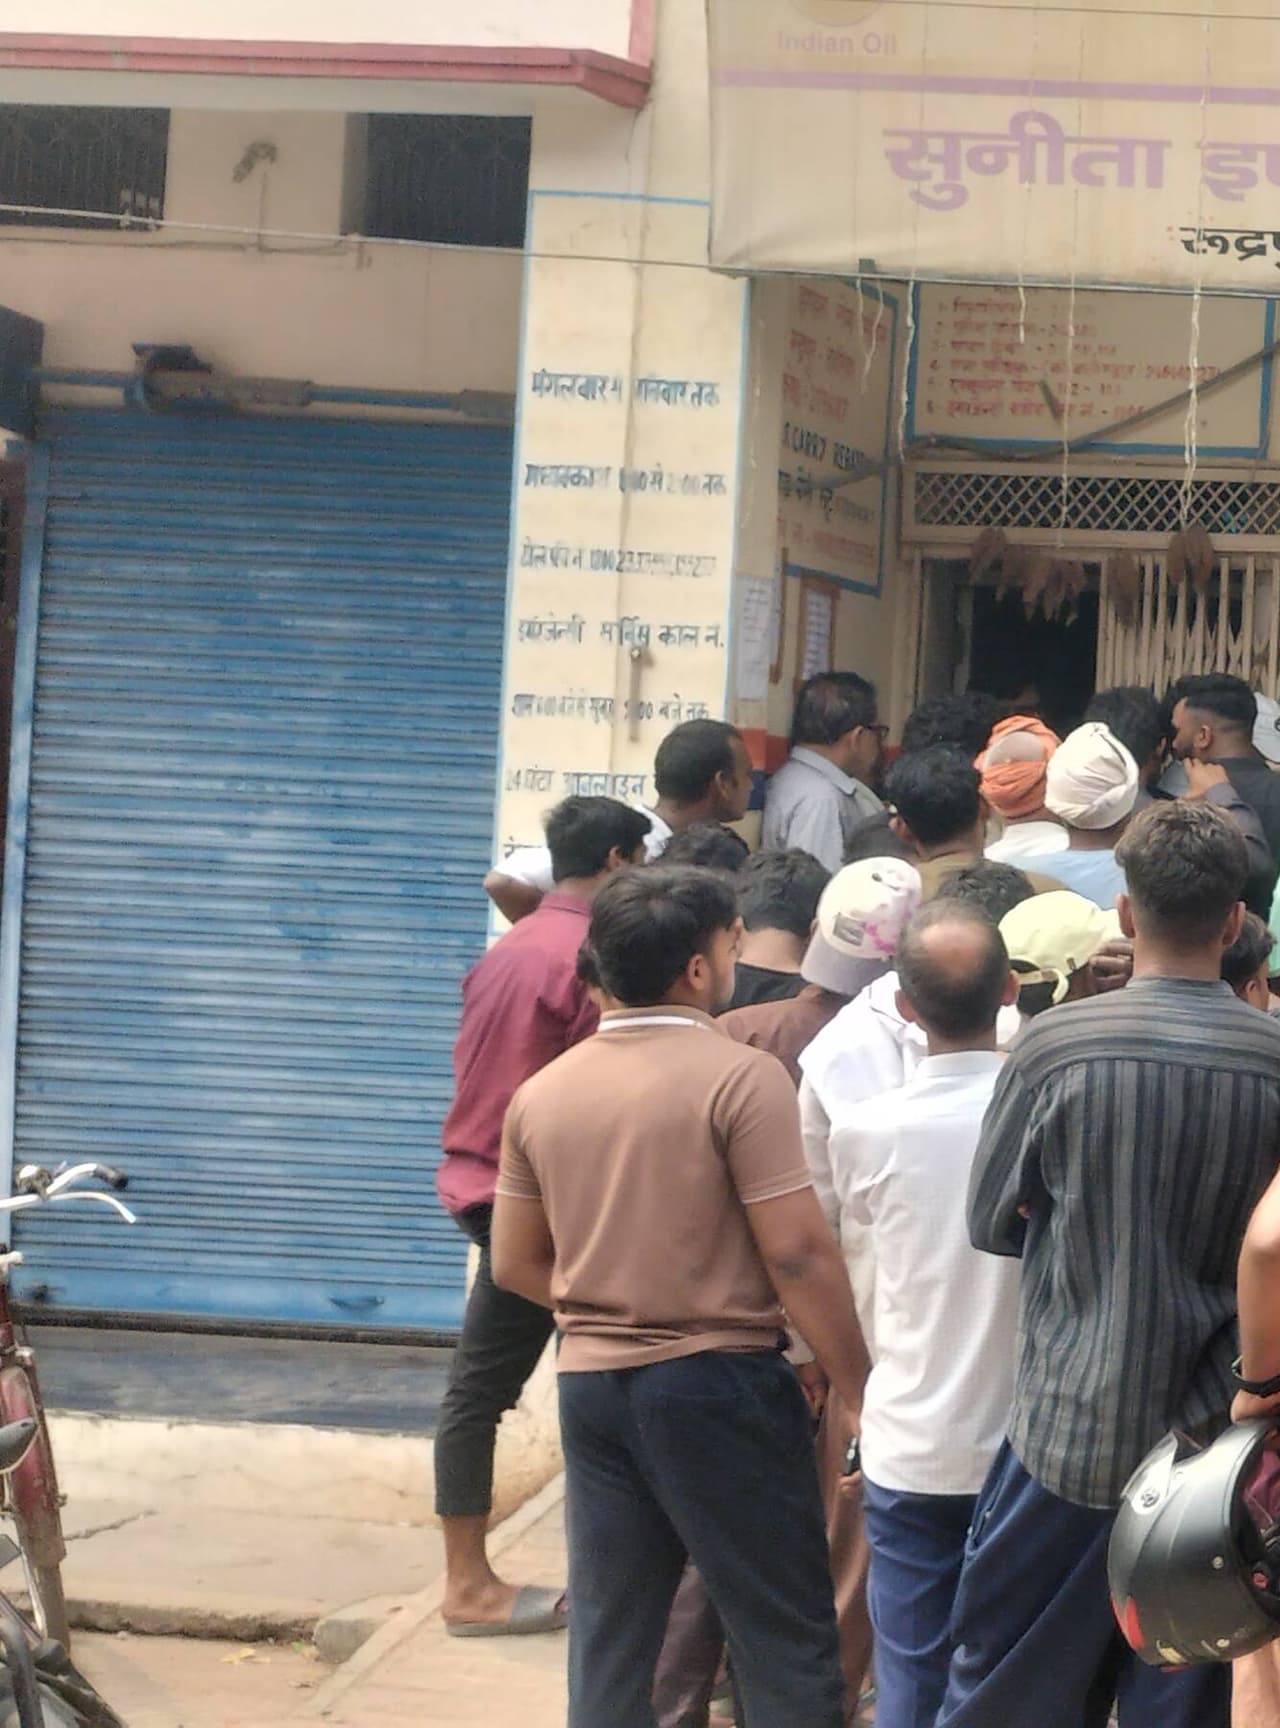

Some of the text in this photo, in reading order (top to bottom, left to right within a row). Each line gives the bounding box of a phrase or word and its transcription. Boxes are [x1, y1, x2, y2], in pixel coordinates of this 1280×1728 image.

[778, 30, 897, 55] Indian Oil
[882, 111, 1172, 211] सुनीता
